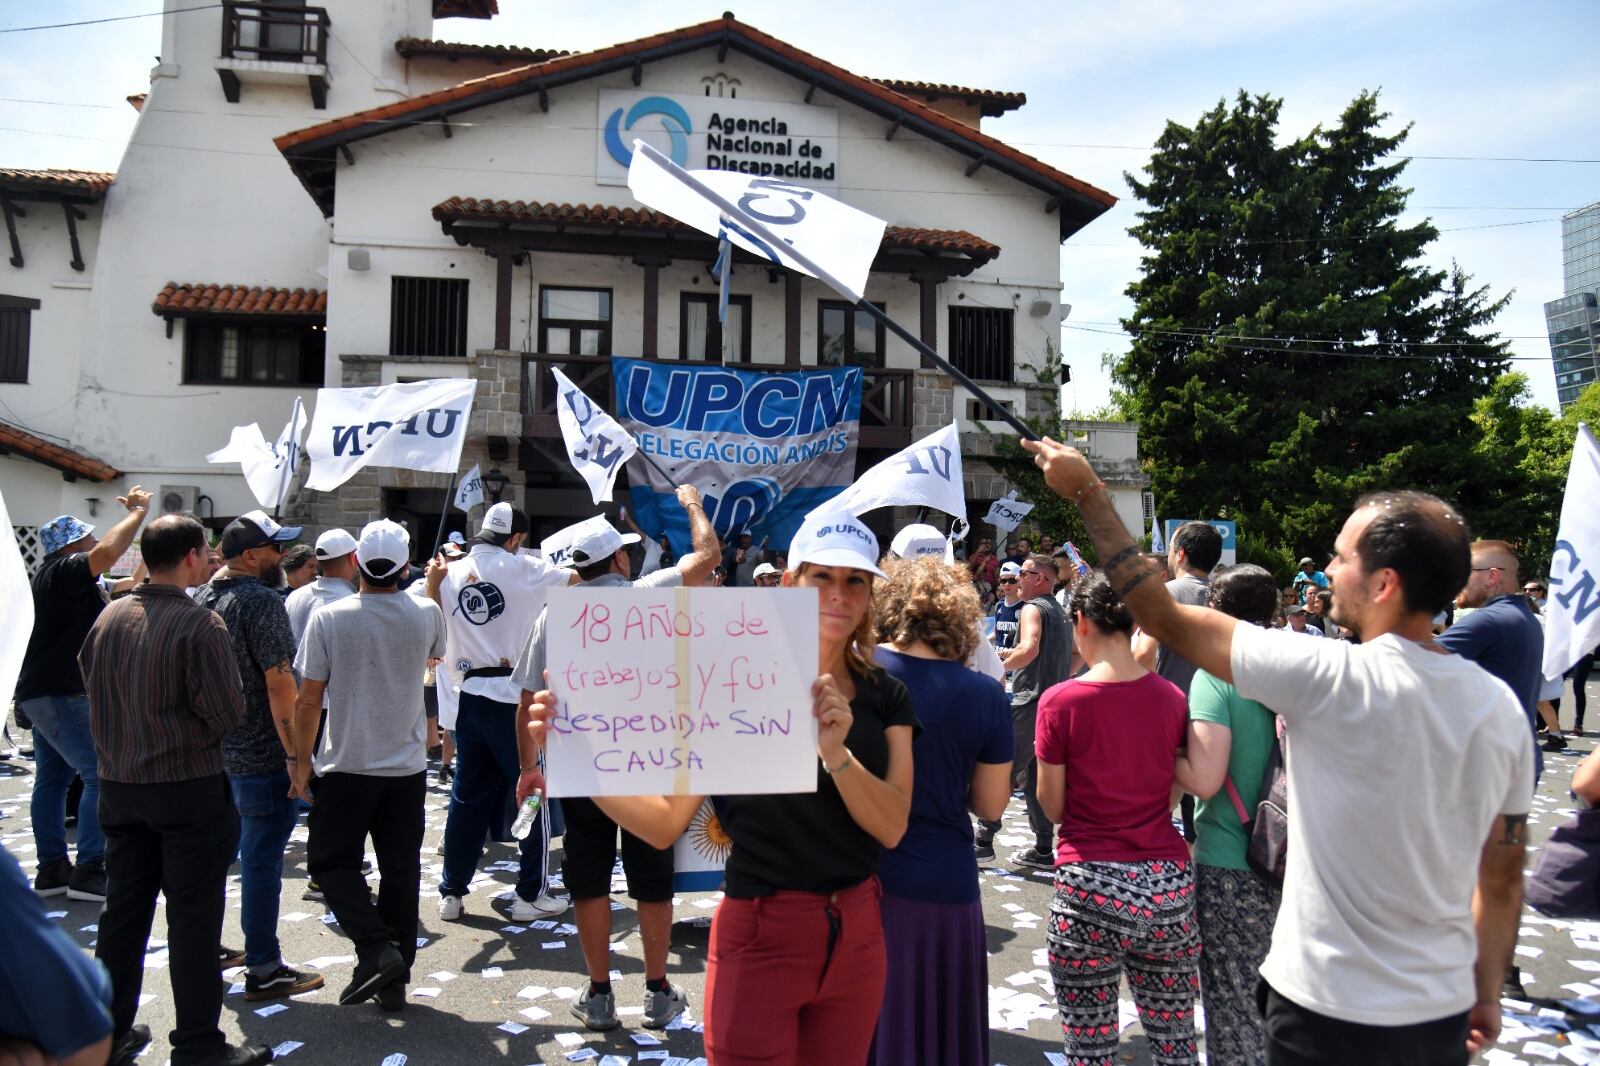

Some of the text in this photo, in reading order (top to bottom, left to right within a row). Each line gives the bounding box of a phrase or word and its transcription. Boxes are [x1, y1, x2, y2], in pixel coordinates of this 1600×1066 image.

[708, 113, 788, 136] Agencia
[707, 133, 822, 159] Nacional de
[707, 155, 835, 181] Discapacidad
[626, 365, 861, 440] UPCN
[836, 524, 872, 545] UPCN
[571, 601, 768, 649] 18 AÑOS de
[562, 655, 778, 709] trabajos y fui
[594, 748, 703, 772] CAUSA
